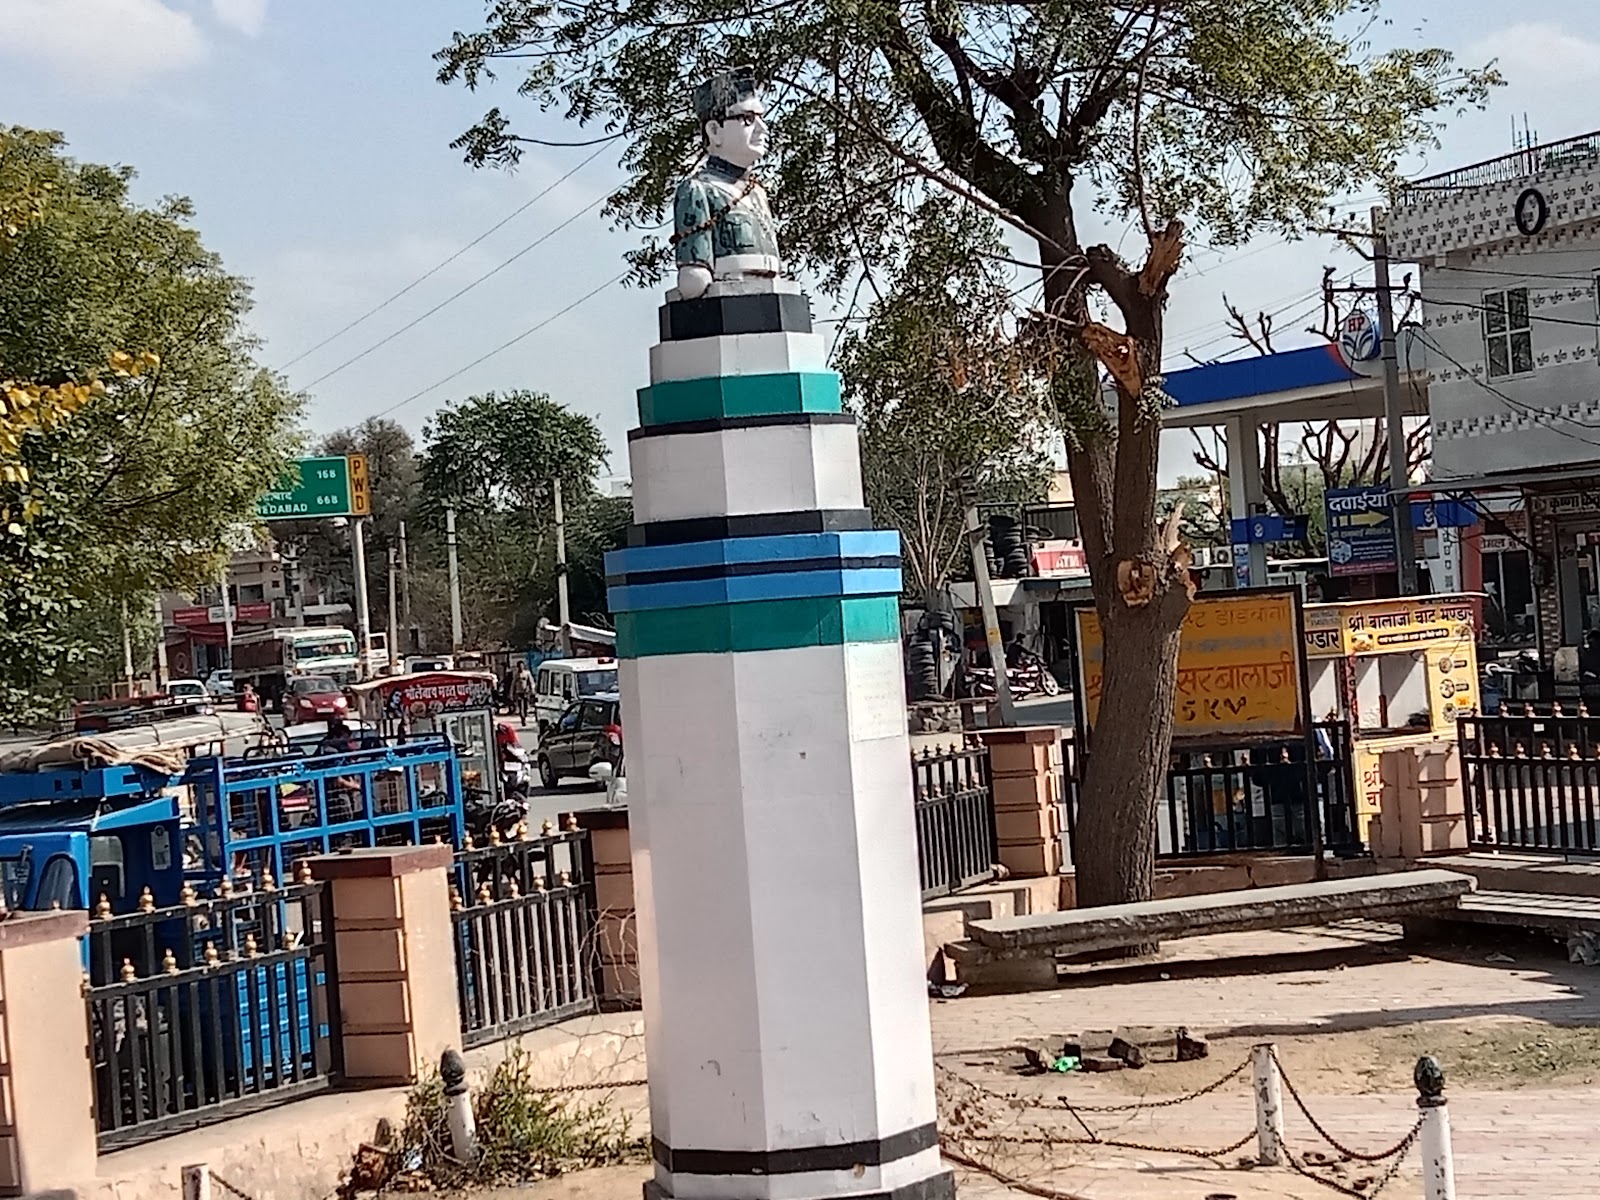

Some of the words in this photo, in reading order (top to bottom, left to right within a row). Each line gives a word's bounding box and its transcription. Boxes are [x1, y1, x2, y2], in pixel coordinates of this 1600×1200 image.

[1347, 315, 1365, 333] HP
[352, 459, 365, 511] PWD
[1055, 553, 1081, 569] ATM
[1349, 611, 1365, 632] श्री
[1368, 605, 1412, 630] बालाजी
[1414, 608, 1437, 625] चाट
[1304, 628, 1340, 649] ण्डार
